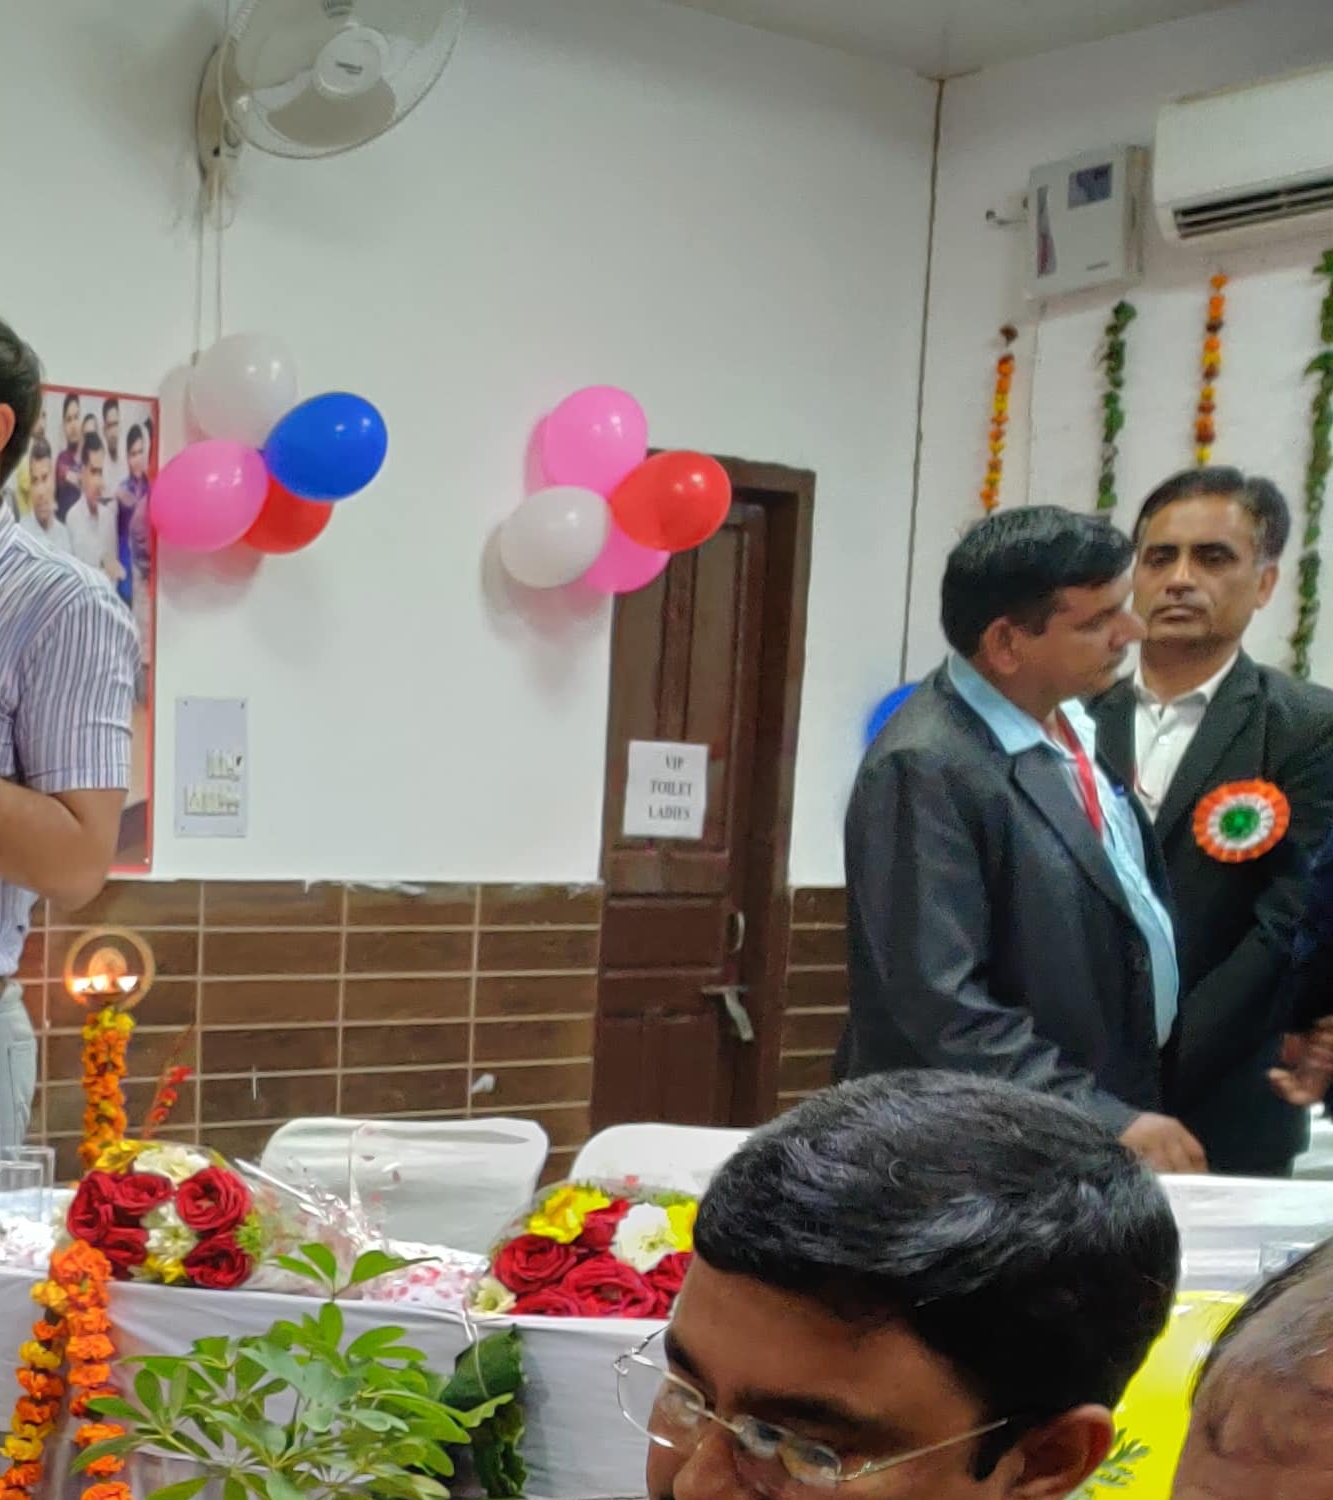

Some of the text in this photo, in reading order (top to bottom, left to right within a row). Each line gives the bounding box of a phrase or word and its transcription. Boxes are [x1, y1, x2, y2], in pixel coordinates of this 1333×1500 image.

[665, 755, 685, 770] VIP
[650, 780, 693, 797] TOILET
[648, 805, 690, 820] LADIES
